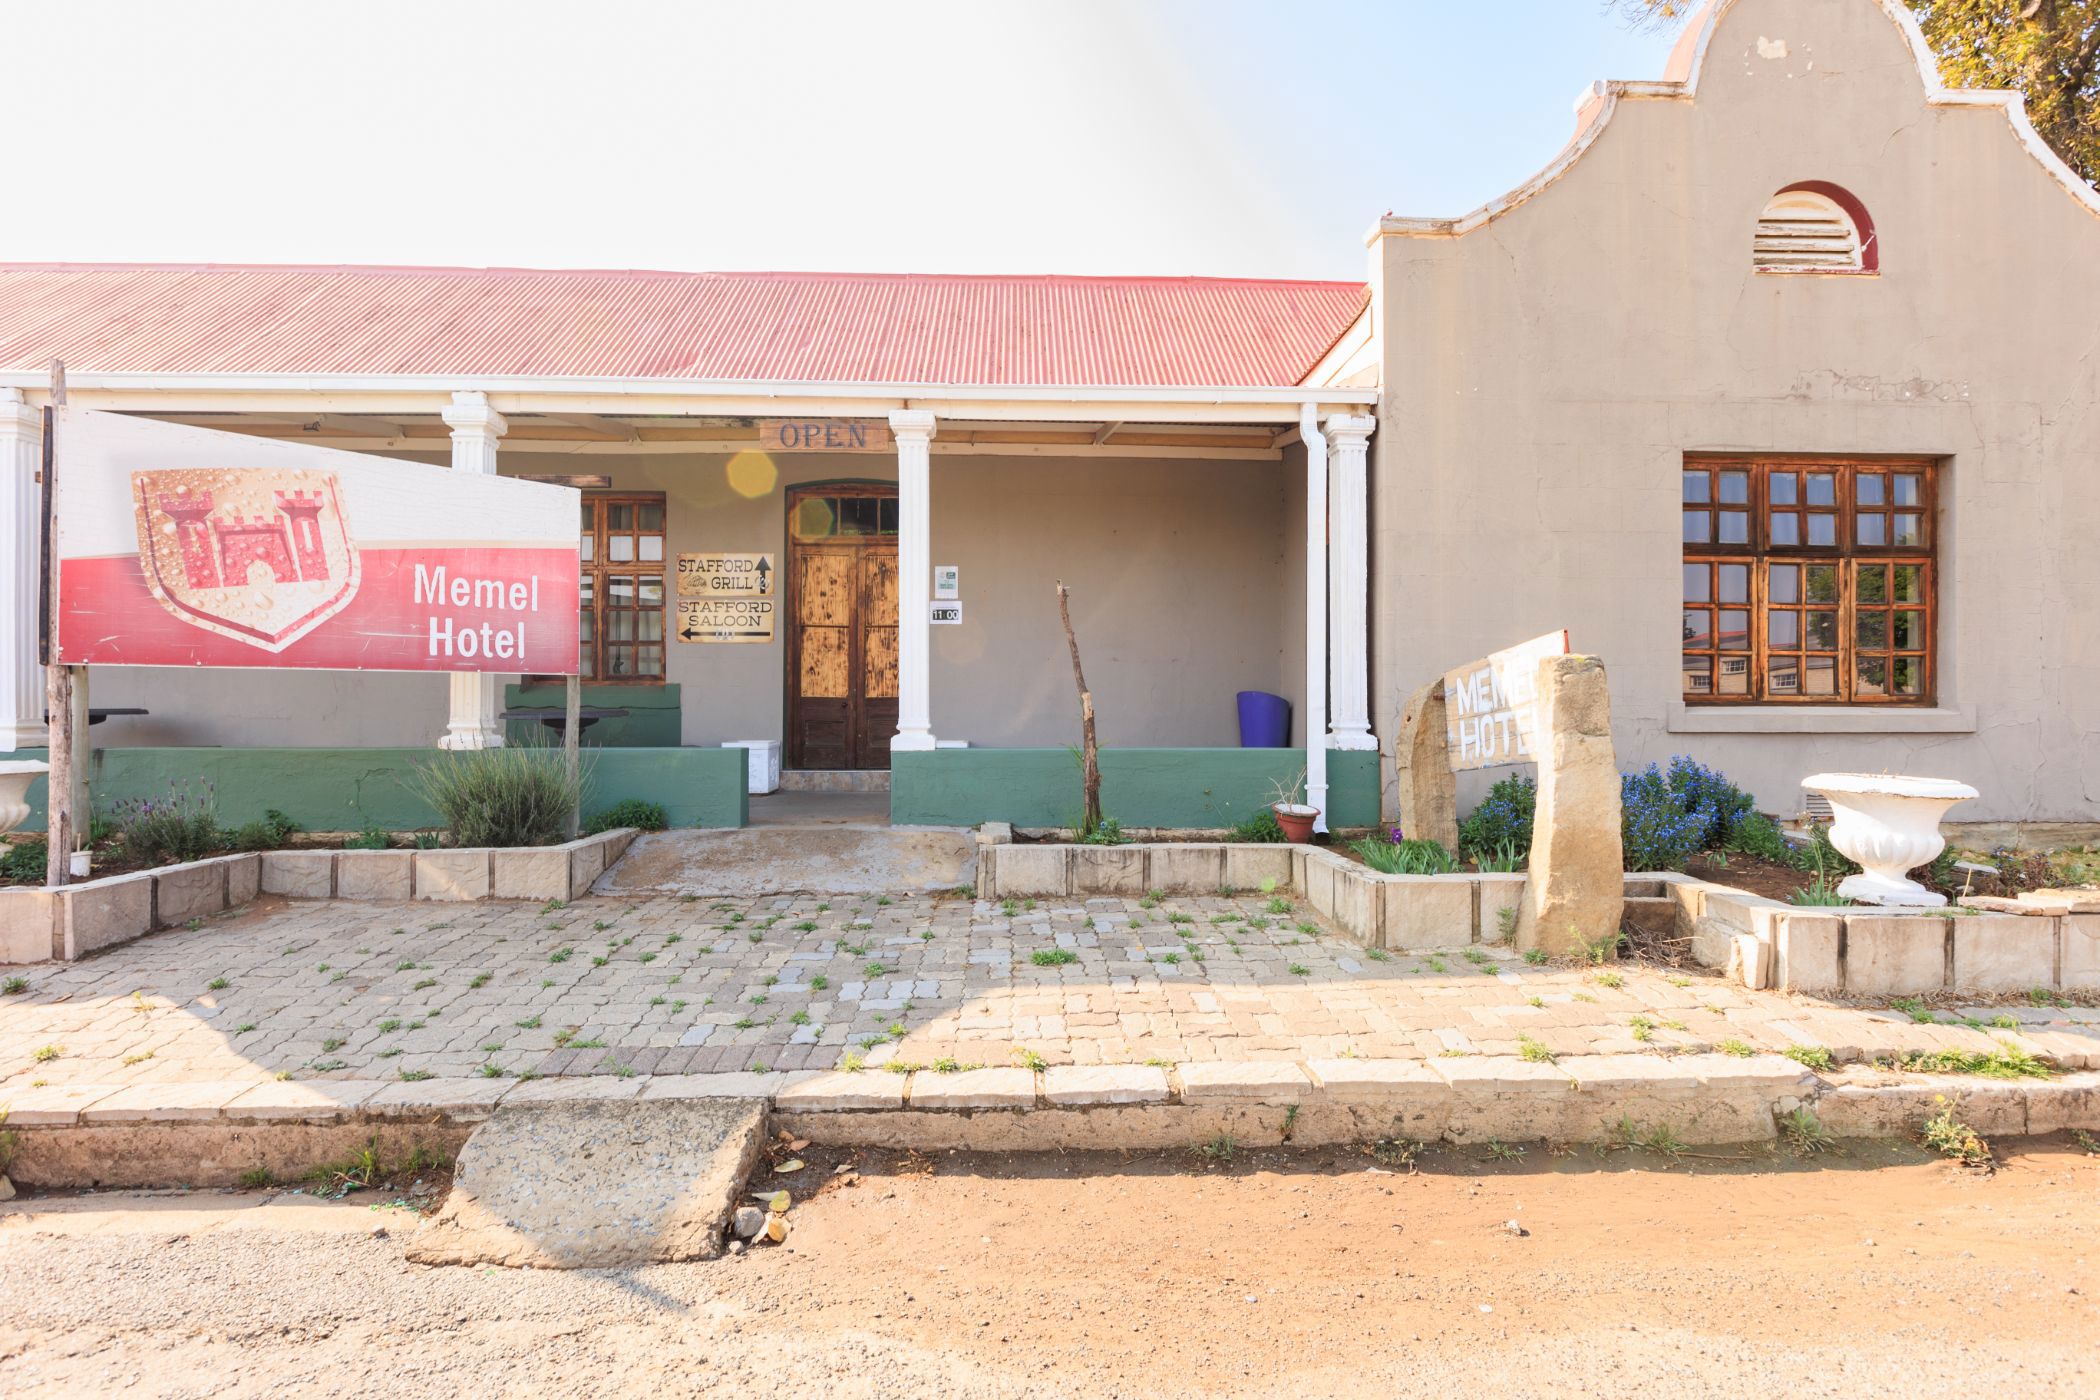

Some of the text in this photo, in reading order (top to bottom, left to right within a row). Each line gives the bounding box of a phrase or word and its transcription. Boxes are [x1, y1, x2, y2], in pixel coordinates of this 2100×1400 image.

[780, 423, 865, 448] OPEN
[678, 559, 754, 573] STAFFORD
[414, 564, 538, 611] Memel
[711, 576, 753, 589] GRILL
[678, 601, 773, 613] STAFFORD
[688, 615, 762, 627] SALOON
[429, 616, 526, 659] Hotel
